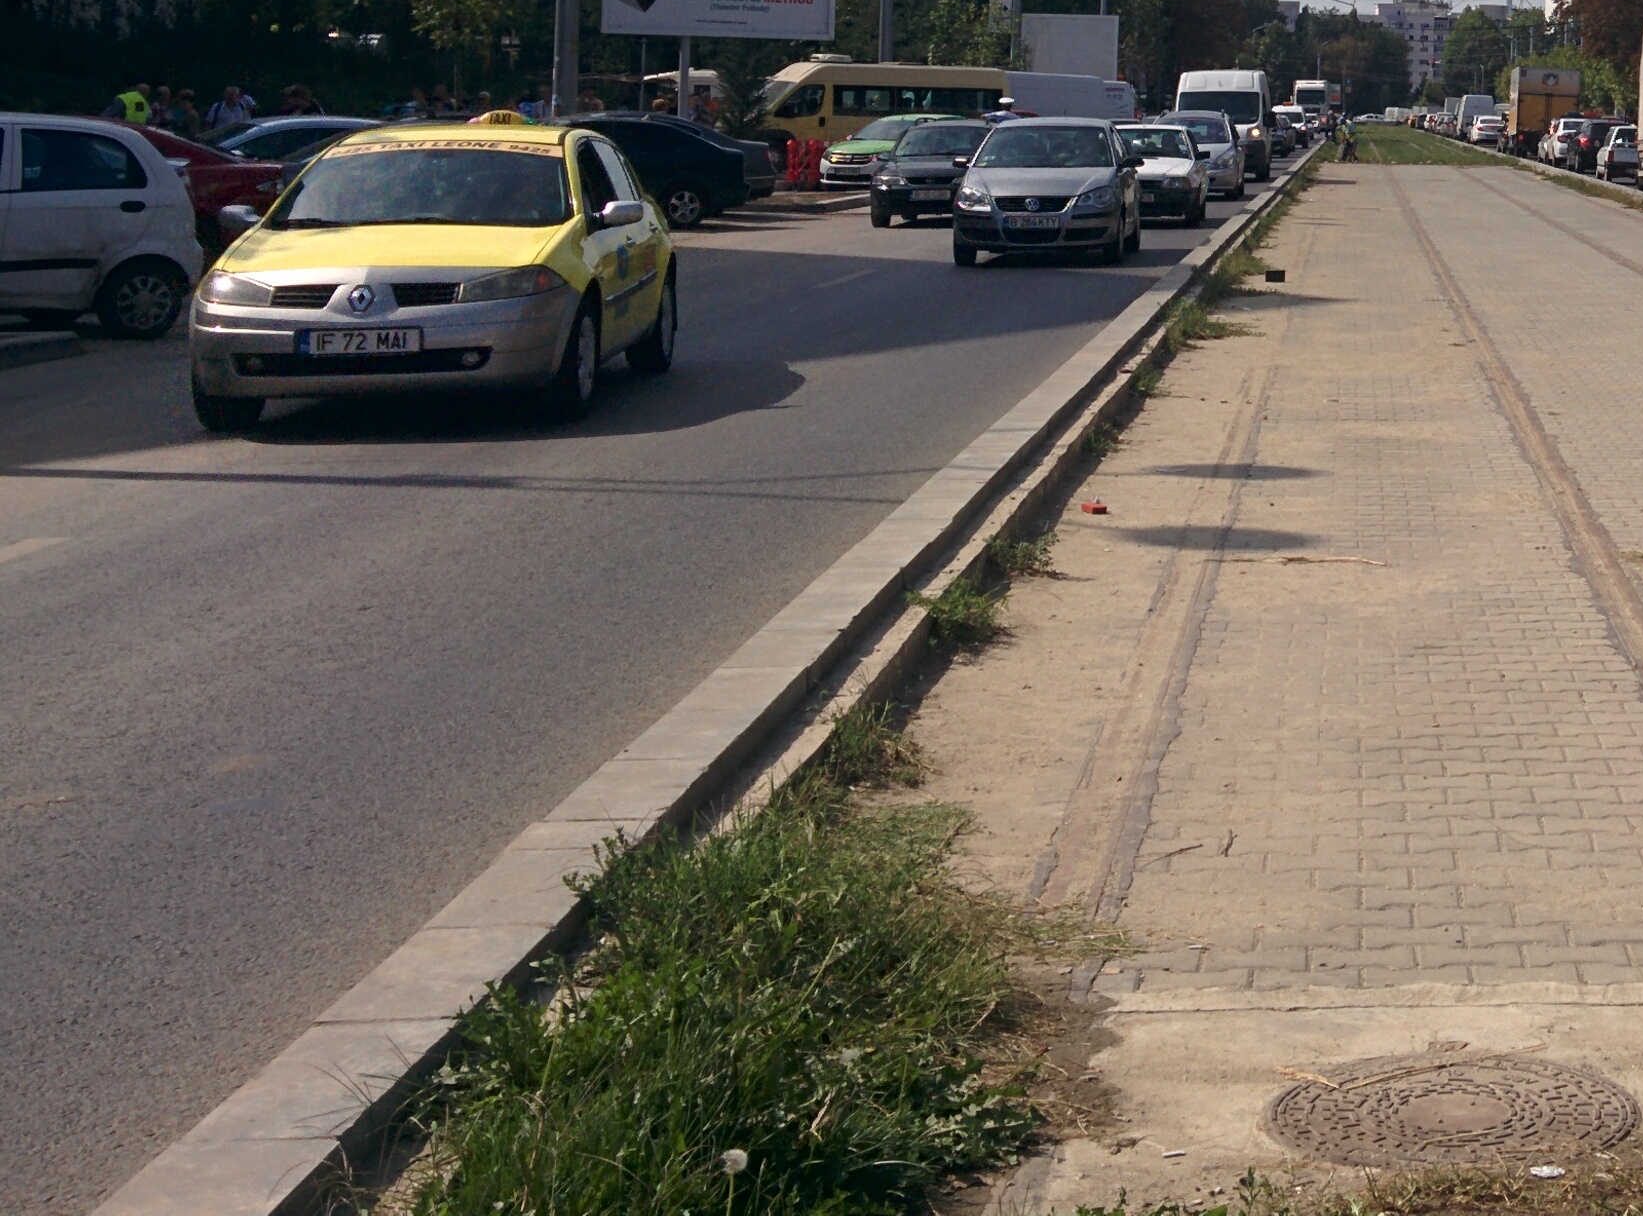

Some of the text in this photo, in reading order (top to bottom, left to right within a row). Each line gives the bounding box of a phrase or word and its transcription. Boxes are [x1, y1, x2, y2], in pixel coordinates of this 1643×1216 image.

[489, 112, 511, 125] TAXI
[380, 141, 426, 150] TAXI
[432, 140, 502, 149] LEONE
[316, 331, 408, 352] IF 72 MAI
